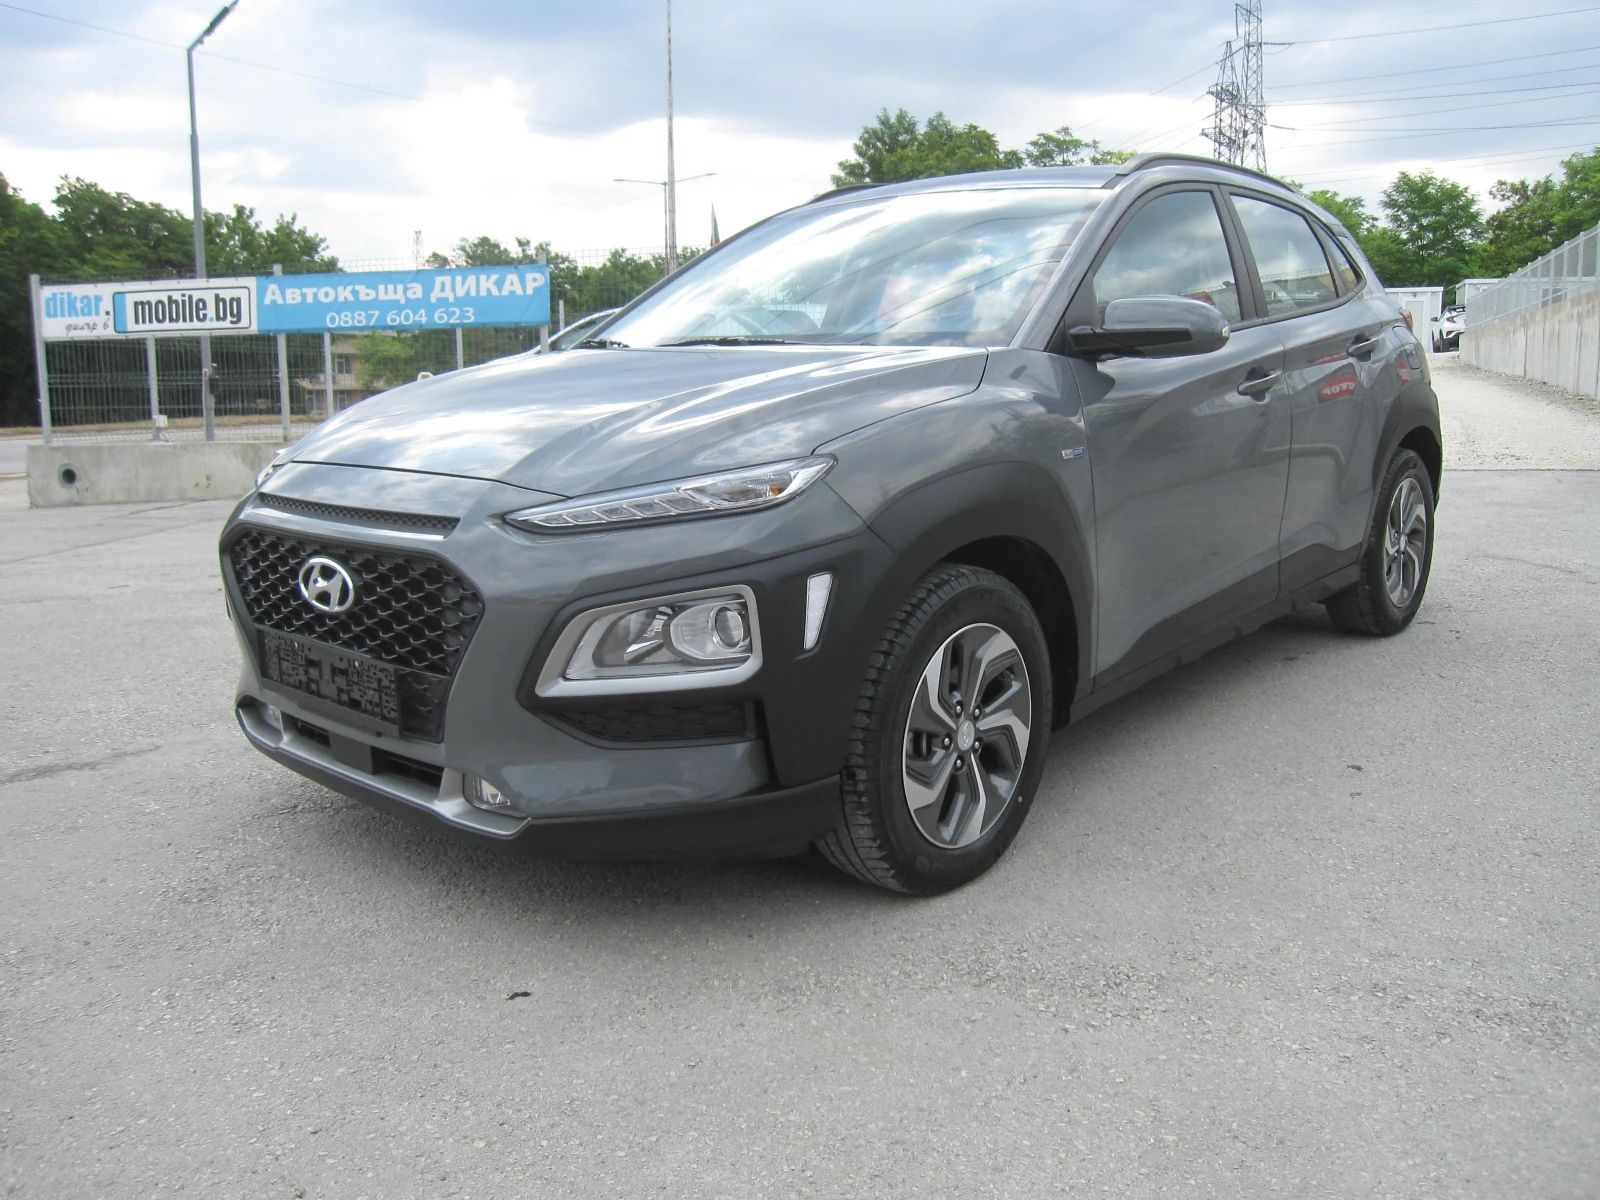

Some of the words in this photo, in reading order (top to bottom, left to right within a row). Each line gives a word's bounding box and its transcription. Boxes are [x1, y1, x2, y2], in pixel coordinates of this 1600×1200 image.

[264, 282, 423, 305] Автокъща
[430, 272, 545, 303] ДИКАР
[133, 292, 242, 325] mobile.bg
[326, 310, 380, 328] 0887
[386, 308, 428, 326] 604
[434, 307, 475, 323] 623
